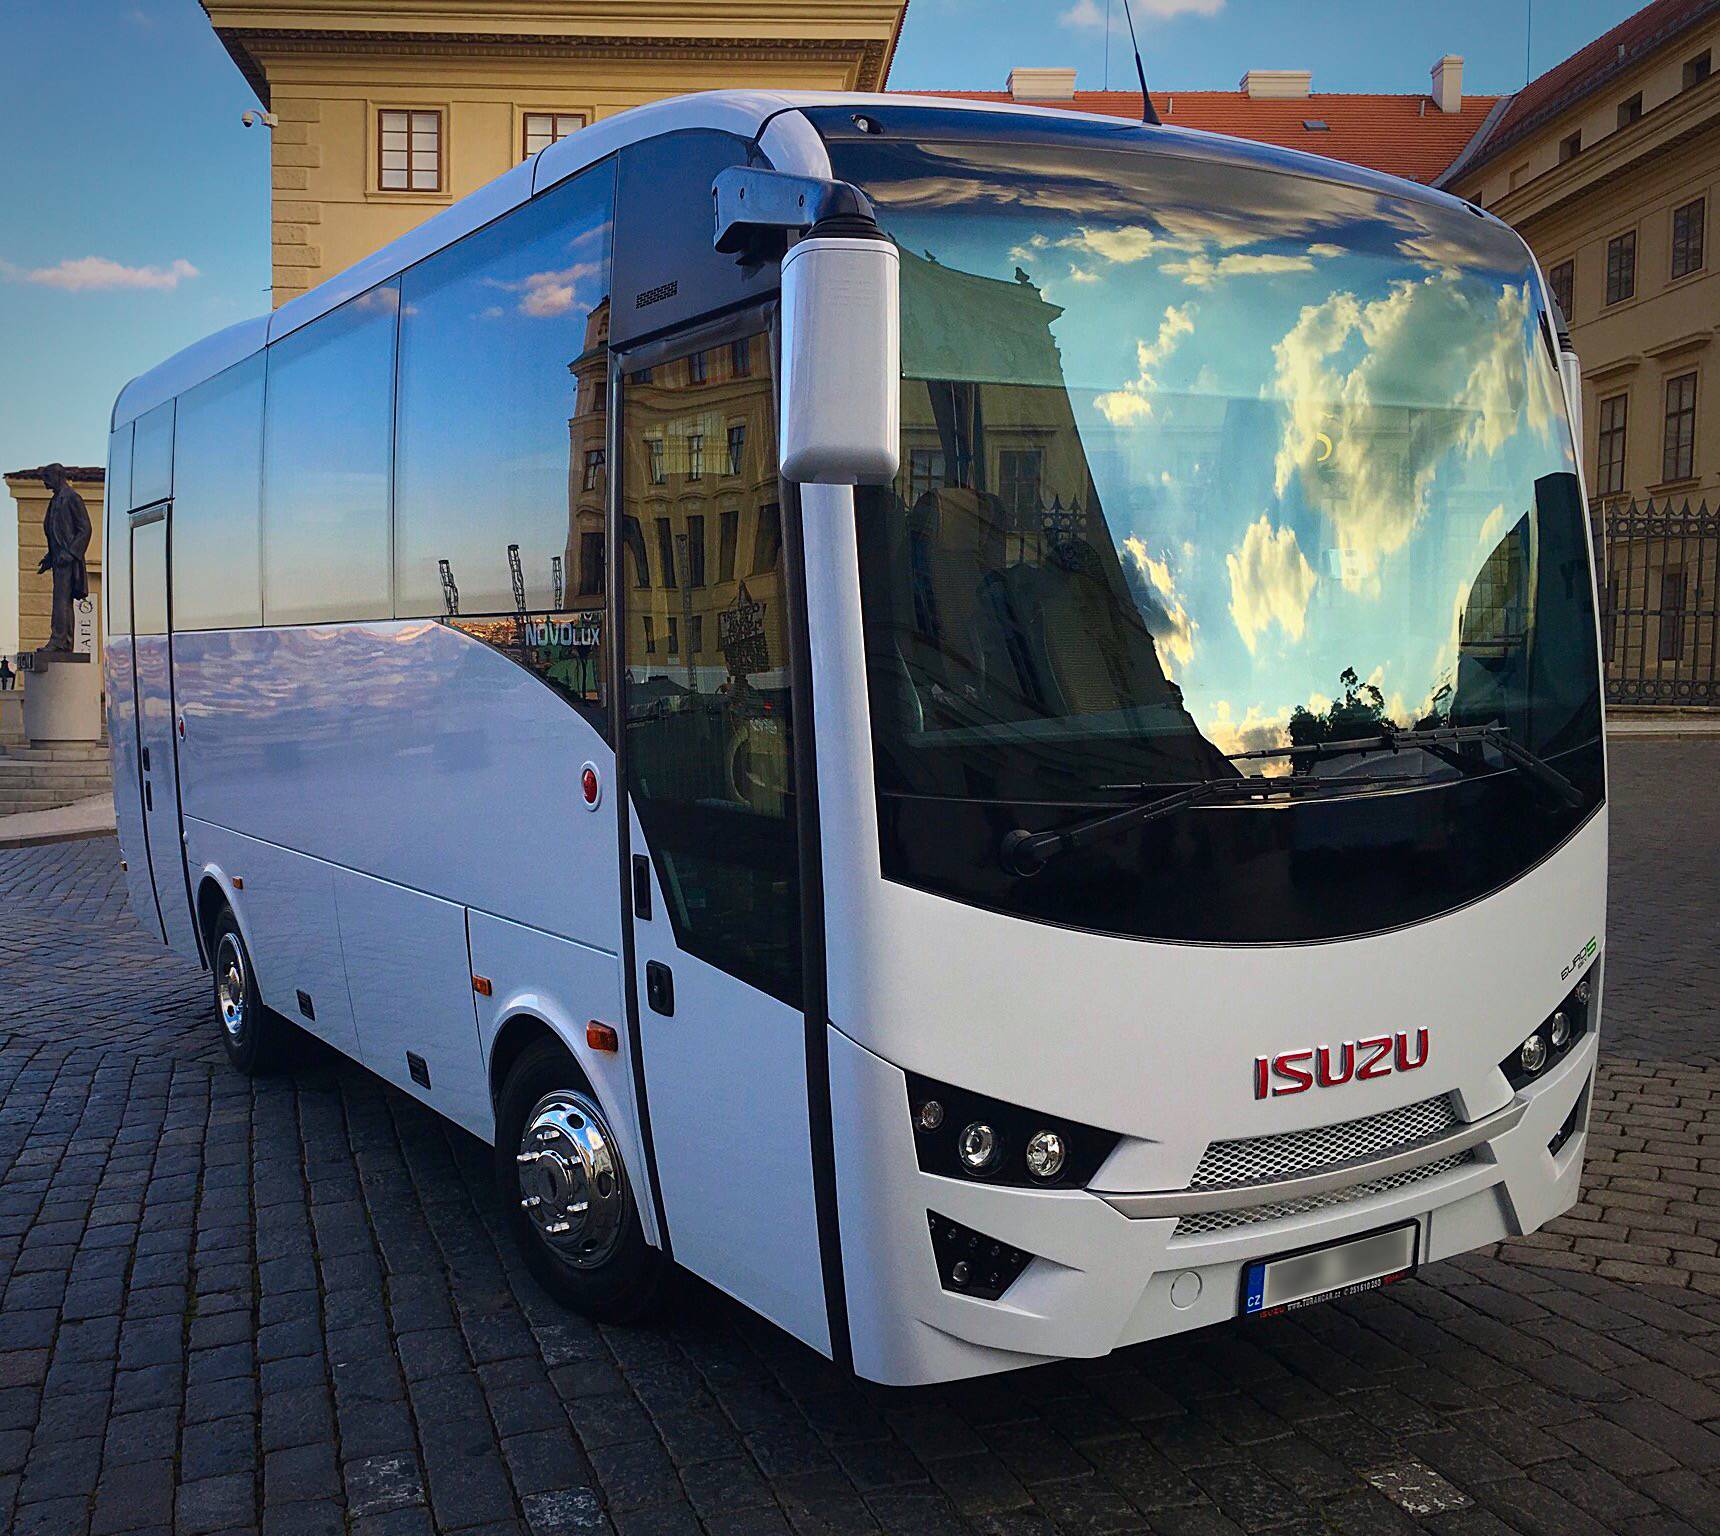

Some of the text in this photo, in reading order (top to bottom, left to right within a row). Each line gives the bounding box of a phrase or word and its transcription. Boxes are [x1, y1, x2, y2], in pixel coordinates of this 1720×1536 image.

[525, 622, 600, 646] NOVOLUX
[1254, 1025, 1430, 1100] ISUZU
[1247, 1293, 1261, 1308] CZ
